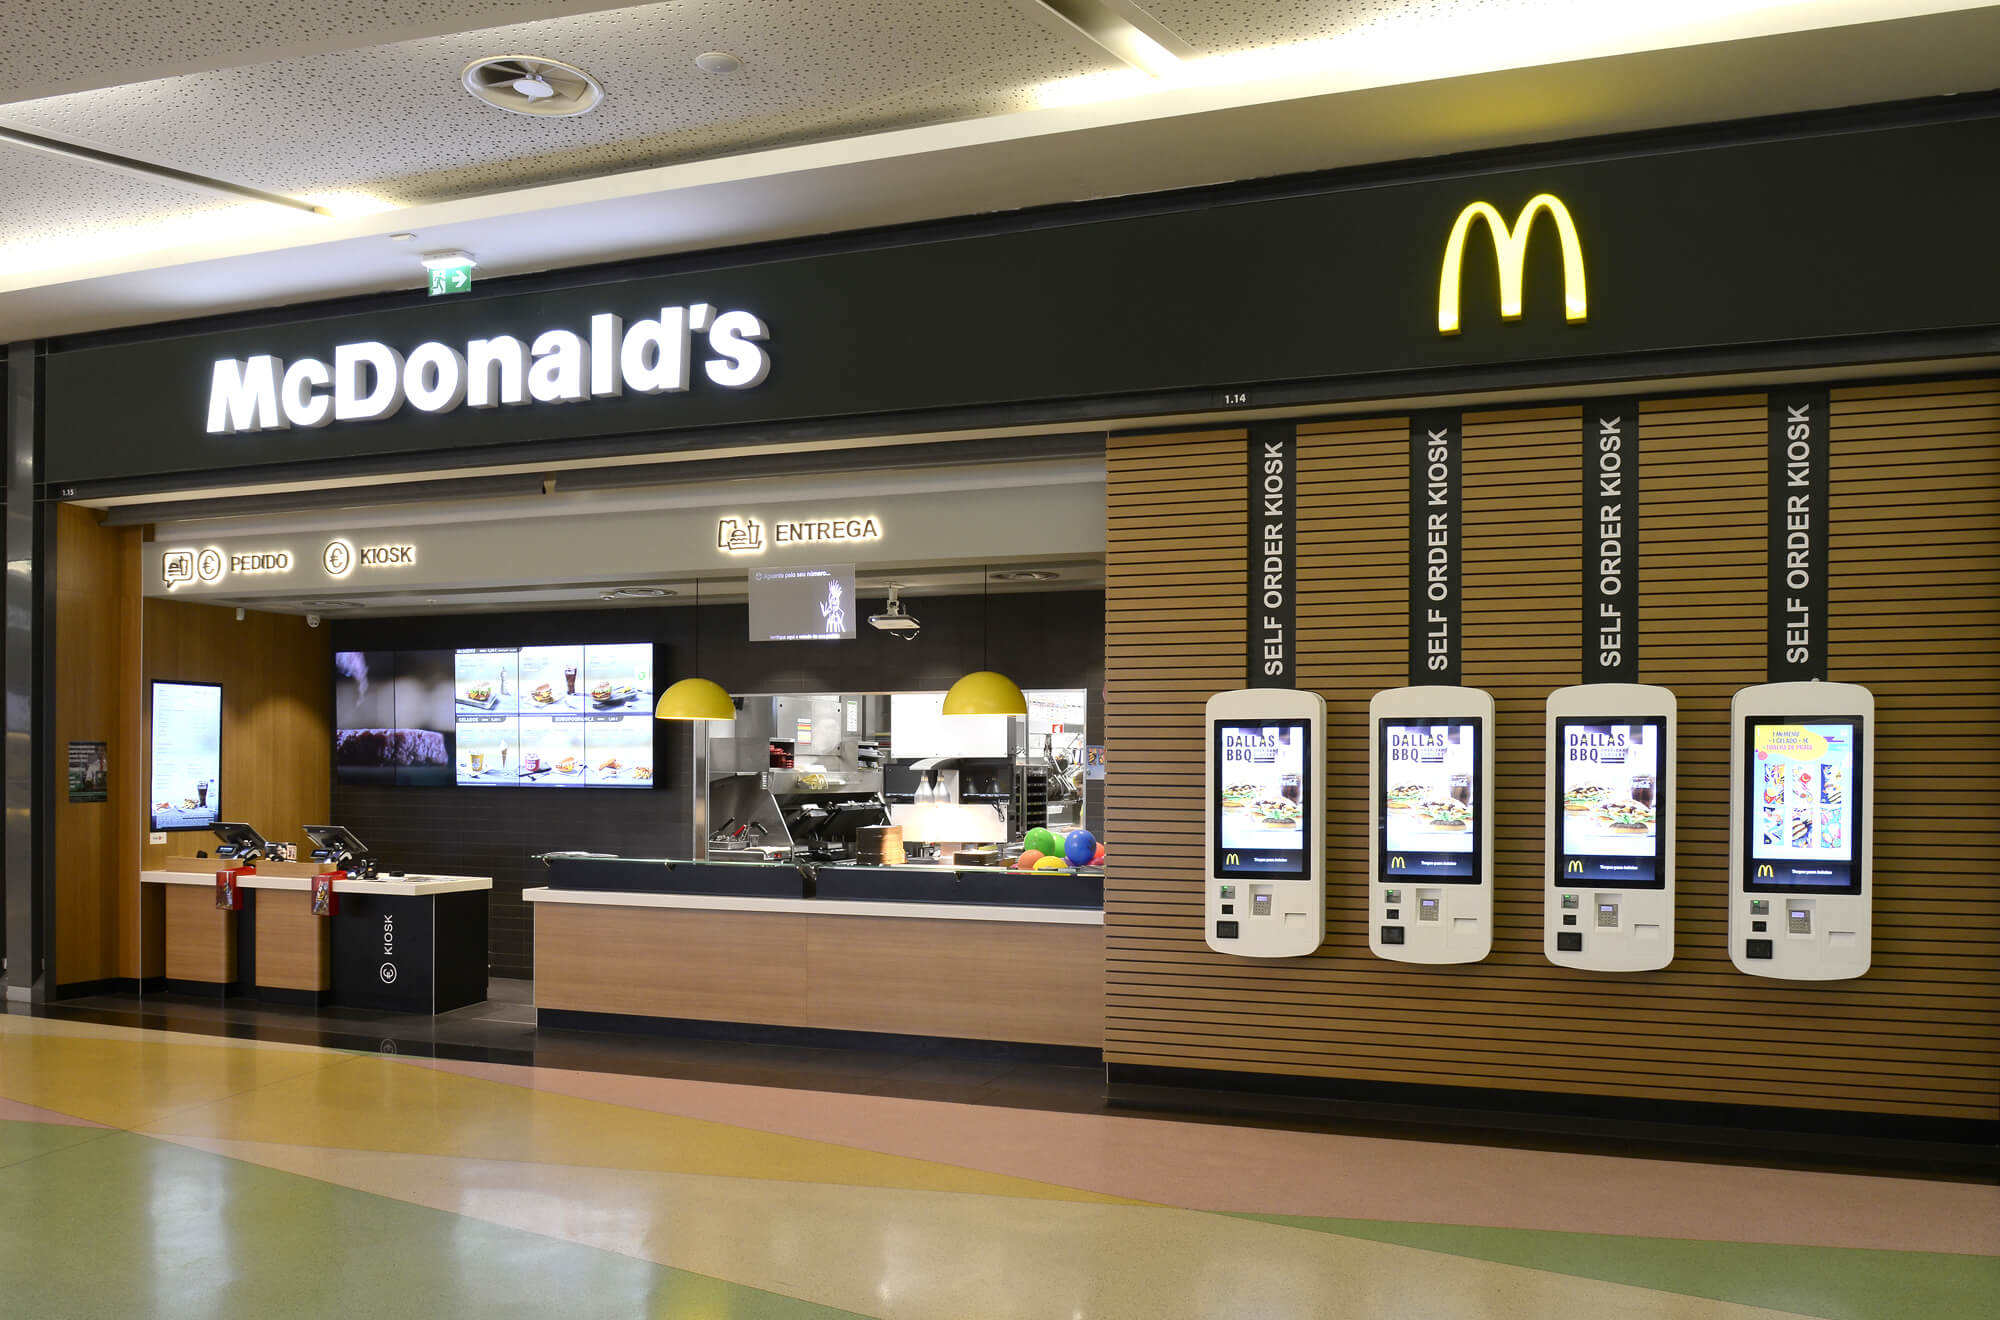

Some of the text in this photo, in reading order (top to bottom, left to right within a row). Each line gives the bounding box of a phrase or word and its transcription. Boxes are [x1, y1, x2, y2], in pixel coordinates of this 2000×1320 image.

[206, 302, 770, 435] McDonald's
[1225, 393, 1247, 405] 1.14
[775, 519, 878, 542] ENTREGA
[1787, 404, 1810, 664] SELF ORDER KIOSK
[1427, 428, 1447, 671] SELF ORDER KIOSK
[1599, 416, 1621, 667] SELF ORDER KIOSK
[230, 553, 289, 573] PEDIDO
[360, 546, 413, 566] KIOSK
[1264, 441, 1283, 676] SELF ORDER KIOSK
[1227, 734, 1275, 748] DALLAS
[1392, 734, 1444, 747] DALLAS
[1570, 733, 1625, 747] DALLAS
[1227, 749, 1252, 763] BBQ
[1392, 748, 1419, 763] BBQ
[1570, 748, 1599, 764] BBQ
[383, 914, 393, 955] KIOSK
